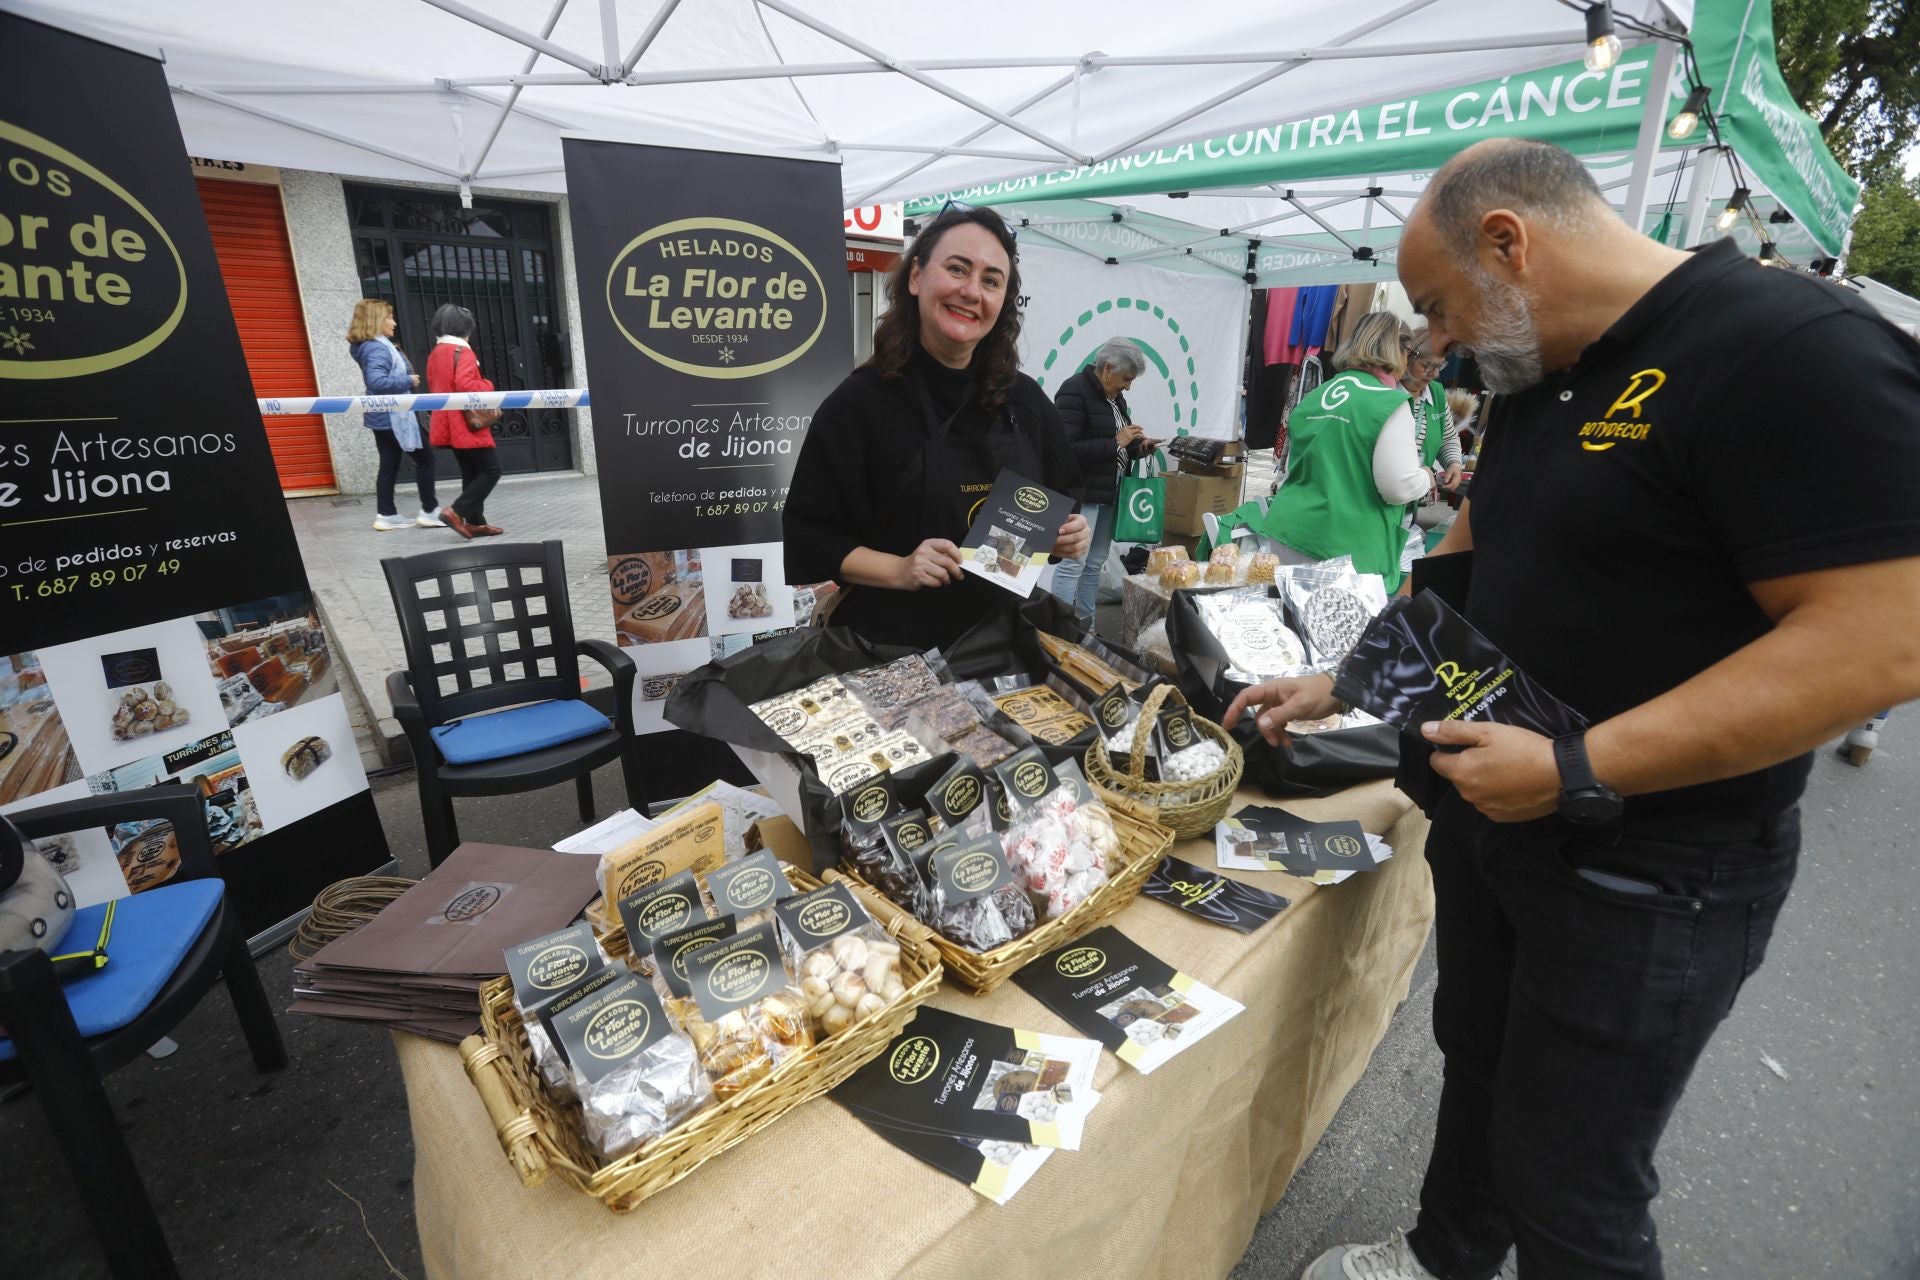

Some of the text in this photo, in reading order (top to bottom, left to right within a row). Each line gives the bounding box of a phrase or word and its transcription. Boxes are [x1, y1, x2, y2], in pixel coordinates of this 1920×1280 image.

[1204, 109, 1363, 159] CONTRA
[1376, 102, 1431, 140] EL
[70, 215, 147, 262] de
[659, 238, 774, 263] HELADOS
[624, 266, 808, 301] La Flor de
[10, 306, 56, 323] 1934
[648, 299, 793, 330] Levante
[692, 334, 749, 344] DESDE 1934
[266, 400, 281, 411] NO
[468, 393, 480, 403] NO
[623, 413, 720, 437] Turrones
[1579, 421, 1652, 440] BOTYDECOR
[51, 430, 236, 464] Artesanos
[679, 435, 792, 460] de Jijona
[44, 468, 171, 503] Jijona
[700, 489, 715, 500] de
[719, 486, 767, 501] pedidos
[771, 488, 777, 498] y
[695, 506, 704, 517] T.
[707, 504, 730, 516] 687
[734, 503, 749, 514] 89
[753, 502, 768, 513] 07
[1015, 521, 1032, 532] Jijona
[18, 531, 237, 574] de pedidos y reservas
[11, 559, 180, 601] T. 687 89 07 49
[1446, 669, 1480, 699] BOTYDECOR
[1486, 694, 1497, 704] 97
[167, 736, 219, 764] TURRONES
[832, 767, 871, 788] La Flor de
[629, 864, 656, 882] HELADOS
[955, 859, 993, 879] La Flor de
[961, 868, 992, 884] Levante
[621, 867, 662, 896] La Flor de
[629, 877, 685, 909] TURRONES ARTESANOS
[730, 874, 769, 897] La Flor de
[737, 882, 769, 902] Levante
[642, 901, 686, 926] La Flor de
[648, 898, 676, 914] HELADOS
[802, 904, 843, 926] La Flor de
[649, 910, 684, 932] Levante
[810, 911, 844, 930] Levante
[518, 929, 582, 956] TURRONES ARTESANOS
[663, 921, 726, 947] TURRONES ARTESANOS
[540, 949, 571, 964] HELADOS
[697, 932, 763, 964] TURRONES ARTESANOS
[1062, 950, 1086, 963] HELADOS
[532, 954, 582, 976] La Flor de
[540, 963, 580, 982] Levante
[713, 958, 763, 986] La Flor de
[719, 954, 752, 972] HELADOS
[1060, 950, 1098, 971] La Flor de
[1068, 955, 1099, 974] Levante
[550, 968, 617, 1014] TURRONES ARTESANOS
[720, 969, 761, 992] Levante
[1071, 964, 1139, 1000] Turrones Artesanos
[1094, 975, 1131, 997] de Jijona
[568, 979, 638, 1023] TURRONES ARTESANOS
[589, 1007, 642, 1045] La Flor de
[594, 1005, 629, 1029] HELADOS
[599, 1020, 641, 1050] Levante
[893, 1044, 911, 1069] HELADOS
[896, 1039, 924, 1080] La Flor de
[907, 1045, 930, 1078] Levante
[933, 1037, 975, 1105] Turrones Artesanos
[954, 1054, 977, 1092] de Jijona
